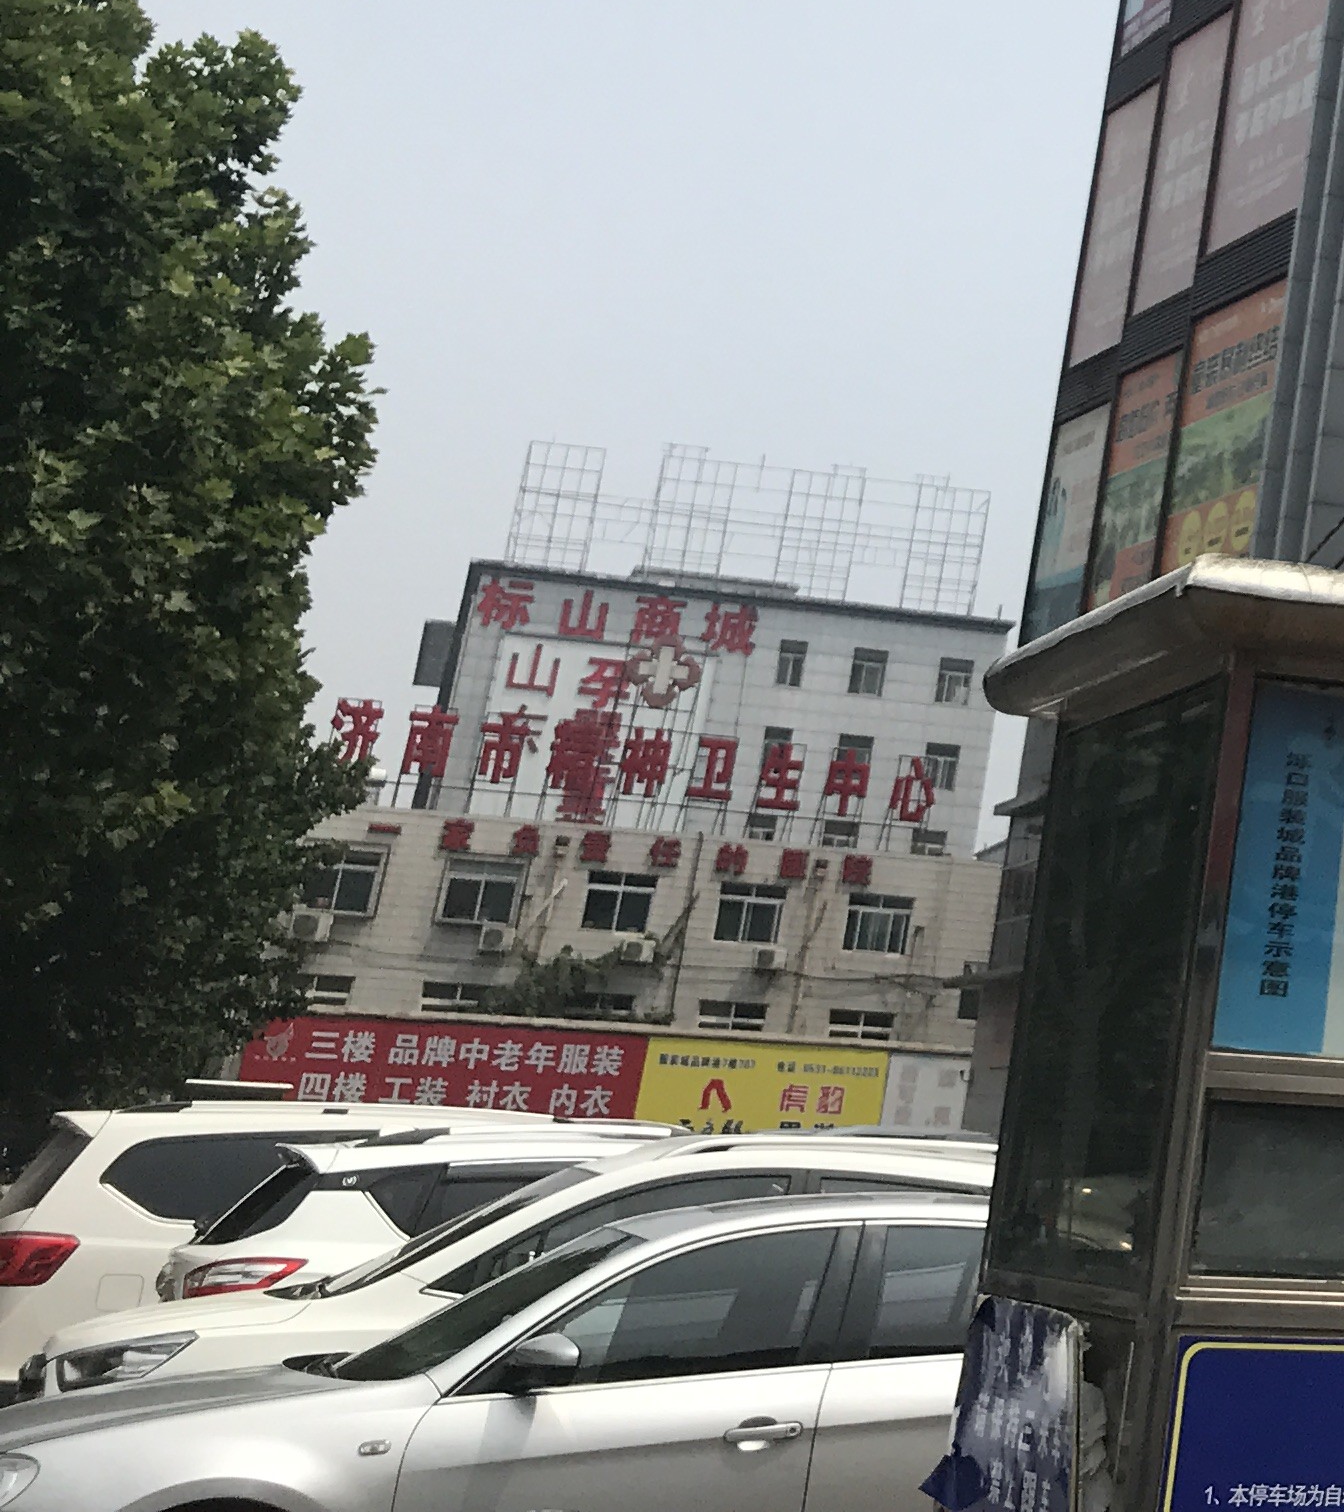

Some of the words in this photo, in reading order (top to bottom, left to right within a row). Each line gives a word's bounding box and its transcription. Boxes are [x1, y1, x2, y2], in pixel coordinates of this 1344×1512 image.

[478, 576, 759, 656] 标山商城
[304, 1029, 376, 1064] 三楼
[388, 1033, 624, 1077] 品牌中老年服装
[299, 1071, 365, 1102] 四楼
[379, 1075, 446, 1104] 工装
[466, 1079, 532, 1110] 衬衣
[549, 1085, 614, 1116] 内衣
